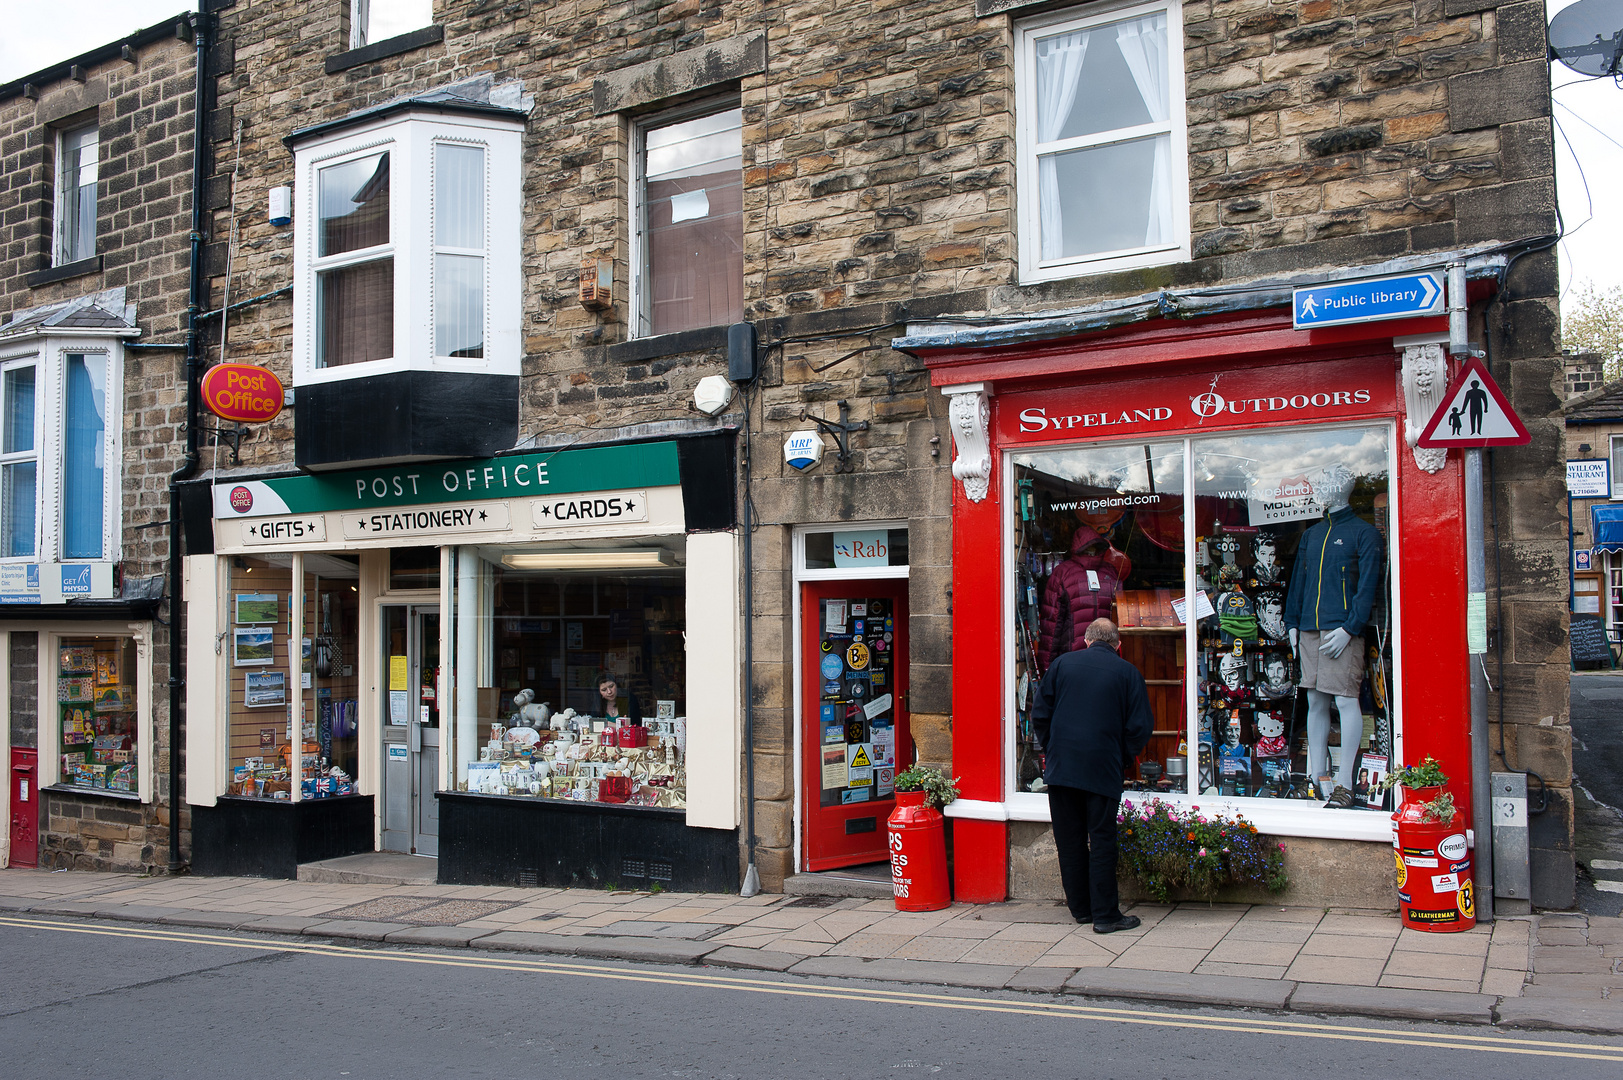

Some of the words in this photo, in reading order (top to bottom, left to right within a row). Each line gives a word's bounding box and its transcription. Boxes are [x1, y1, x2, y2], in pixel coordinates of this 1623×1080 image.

[1324, 295, 1366, 310] Public
[1371, 289, 1418, 304] library
[227, 370, 267, 392] Post
[216, 389, 276, 413] Office
[1019, 406, 1173, 433] SYPELAND
[1190, 389, 1372, 418] OUTDOORS
[789, 438, 813, 449] MRP
[356, 474, 420, 500] POST
[442, 462, 550, 492] OFFICE
[233, 491, 248, 499] POST
[1217, 483, 1342, 500] www.sypeland.com
[232, 499, 251, 507] OFFICE
[554, 498, 623, 520] CARDS
[1050, 493, 1160, 512] www.sypeland.com
[371, 508, 475, 532] STATIONERY
[1266, 507, 1321, 519] EQUIPMEN
[260, 520, 304, 539] GIFTS
[851, 539, 887, 559] Rab
[1503, 803, 1514, 818] 3
[1444, 842, 1466, 852] PRIMUS
